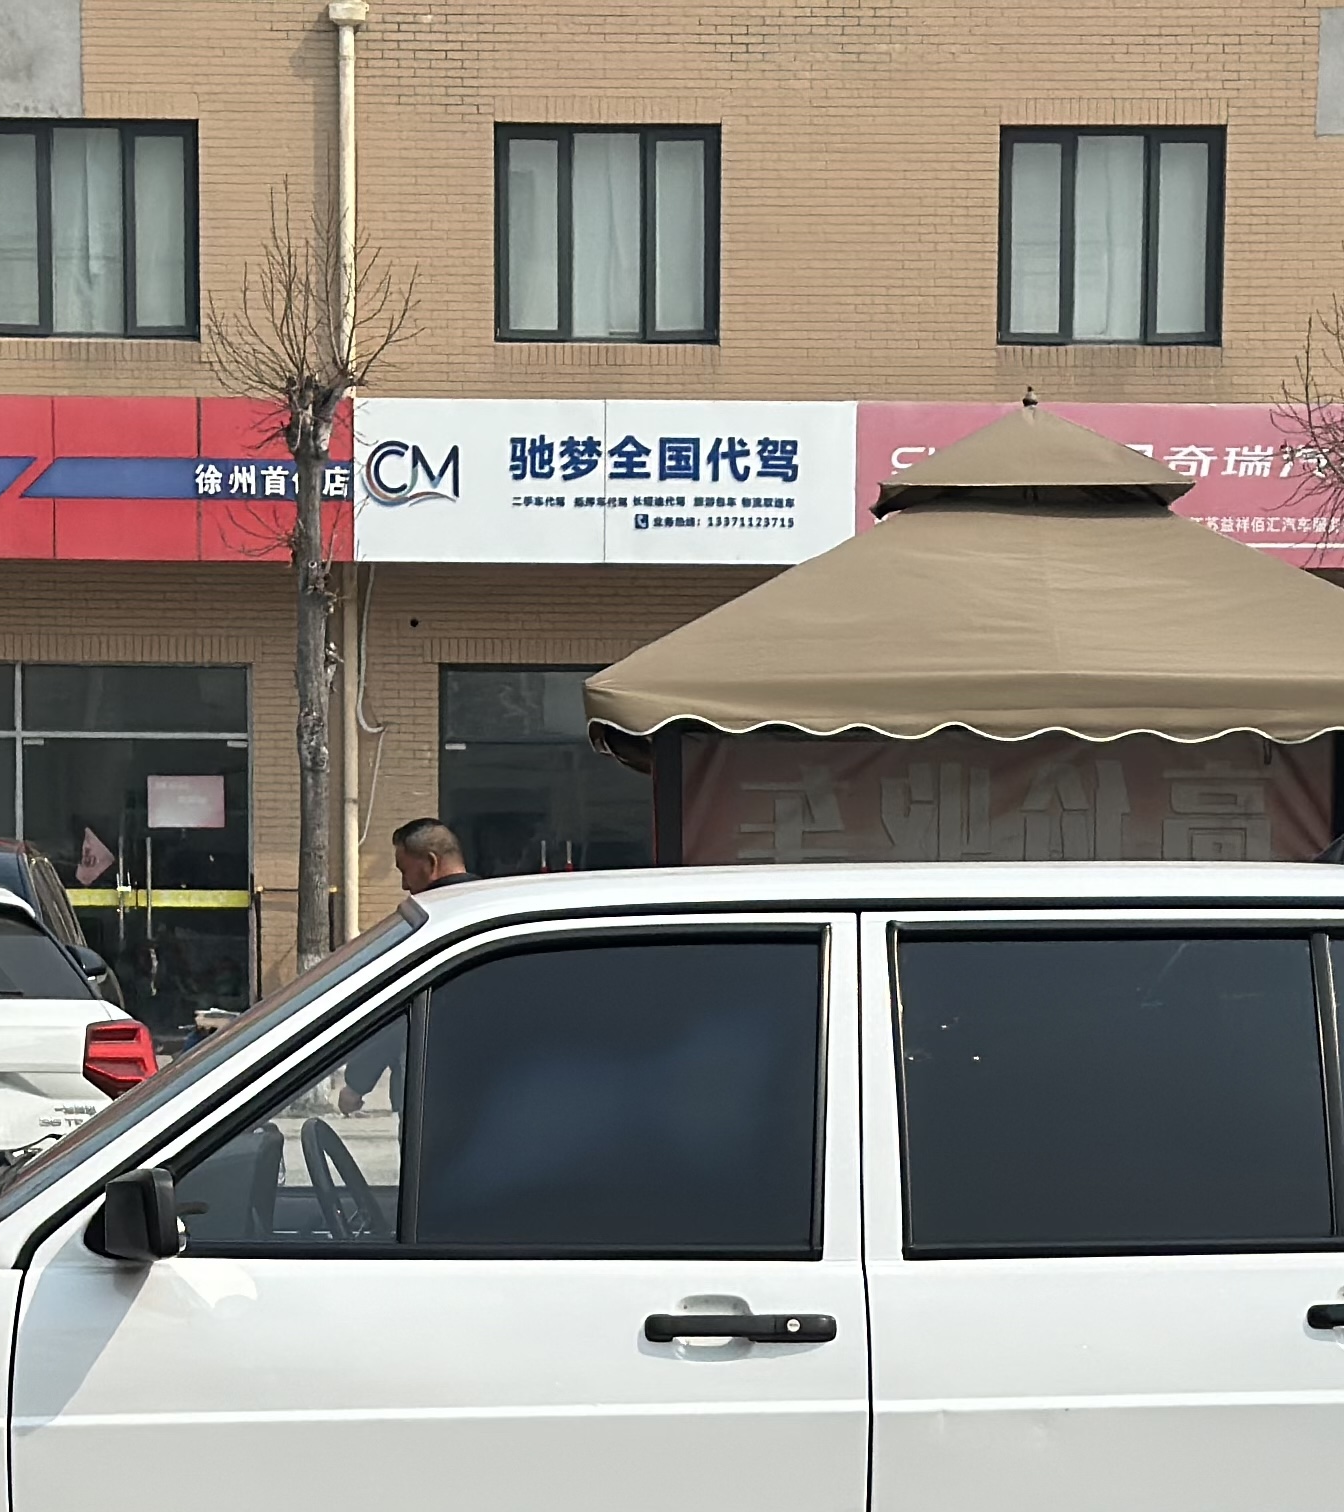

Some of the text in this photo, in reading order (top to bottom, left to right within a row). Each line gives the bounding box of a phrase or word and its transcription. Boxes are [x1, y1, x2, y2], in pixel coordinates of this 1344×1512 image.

[195, 463, 350, 498] 徐州首店
[509, 435, 799, 484] 驰梦全国代驾
